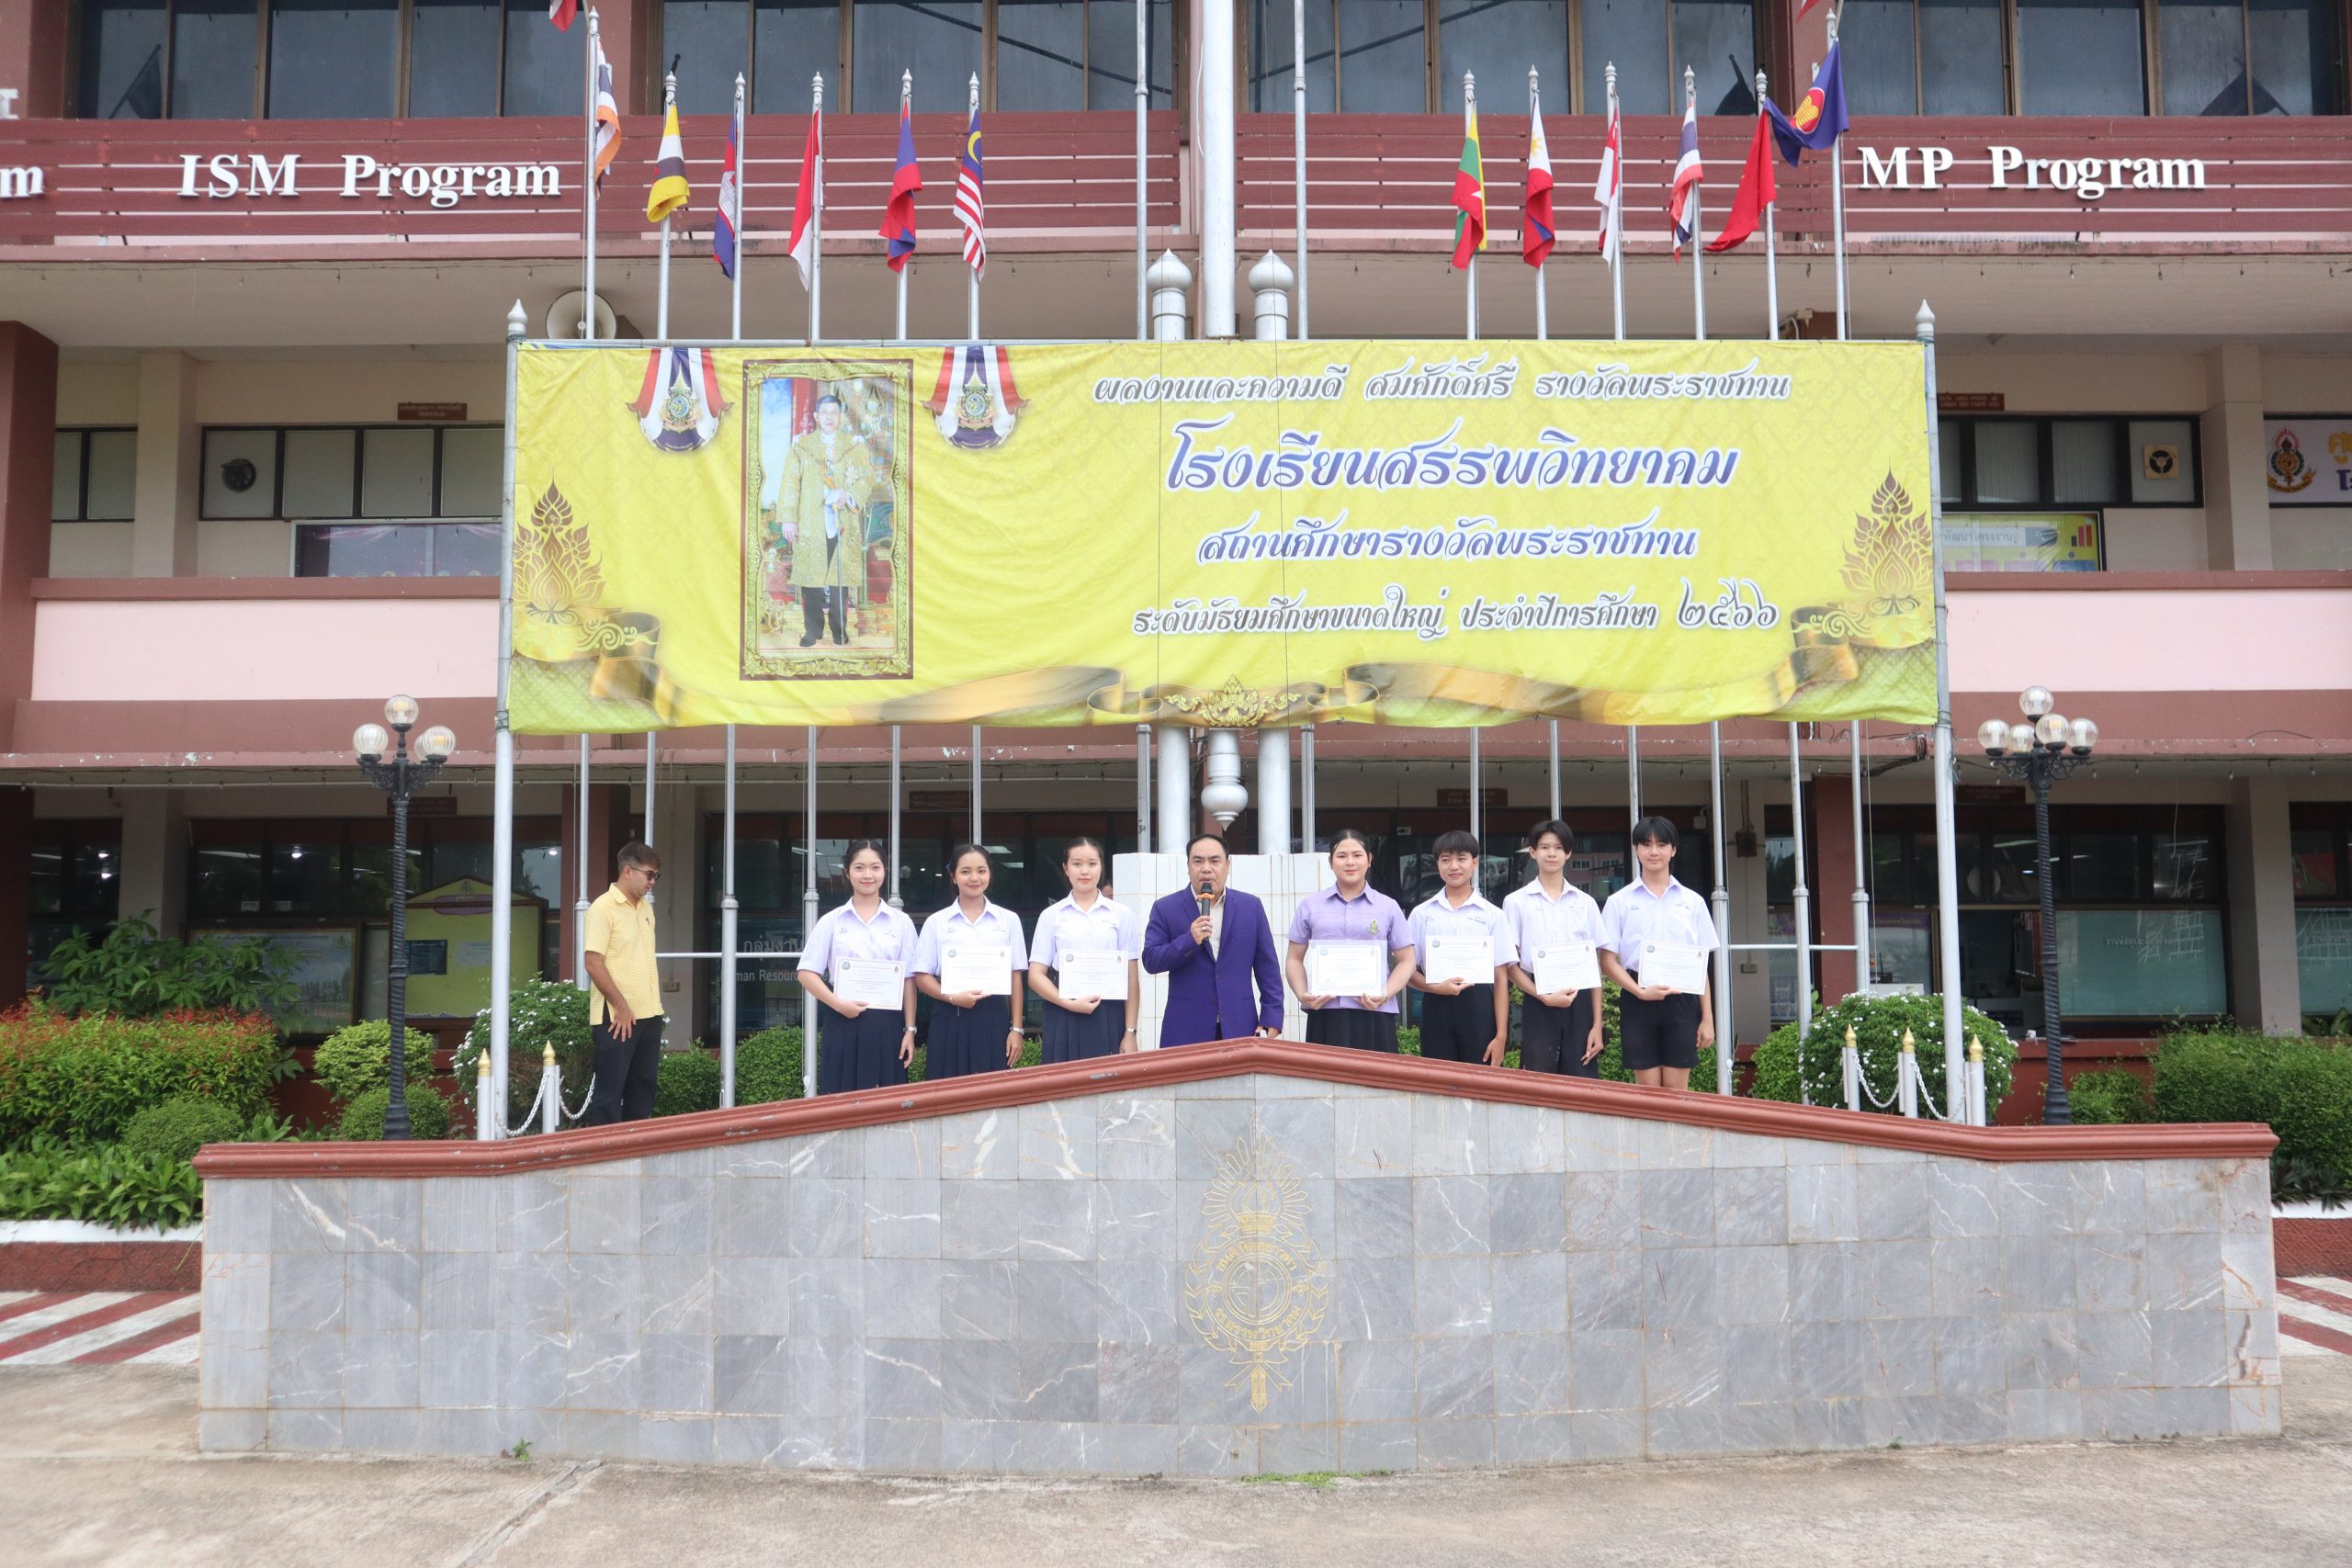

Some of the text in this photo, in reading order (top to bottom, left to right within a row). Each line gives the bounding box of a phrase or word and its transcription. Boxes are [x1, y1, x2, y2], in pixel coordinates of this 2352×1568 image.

[177, 153, 561, 209] ISM Program
[1858, 145, 2207, 200] MP Program
[1094, 356, 1790, 402] ผลงานและความดี สมศักดิ์ศรี รางวัลพระราชทาน
[1168, 413, 1739, 491] โรงเรียนสรรพวิทยาคม
[1198, 508, 1698, 564] สถานศึกษารางวัลพระราชทาน
[1134, 578, 1779, 639] ระดับมัธยมศึกษาขนาดใหญ่ ประจำปีการศึกษา ๒๕๖๖
